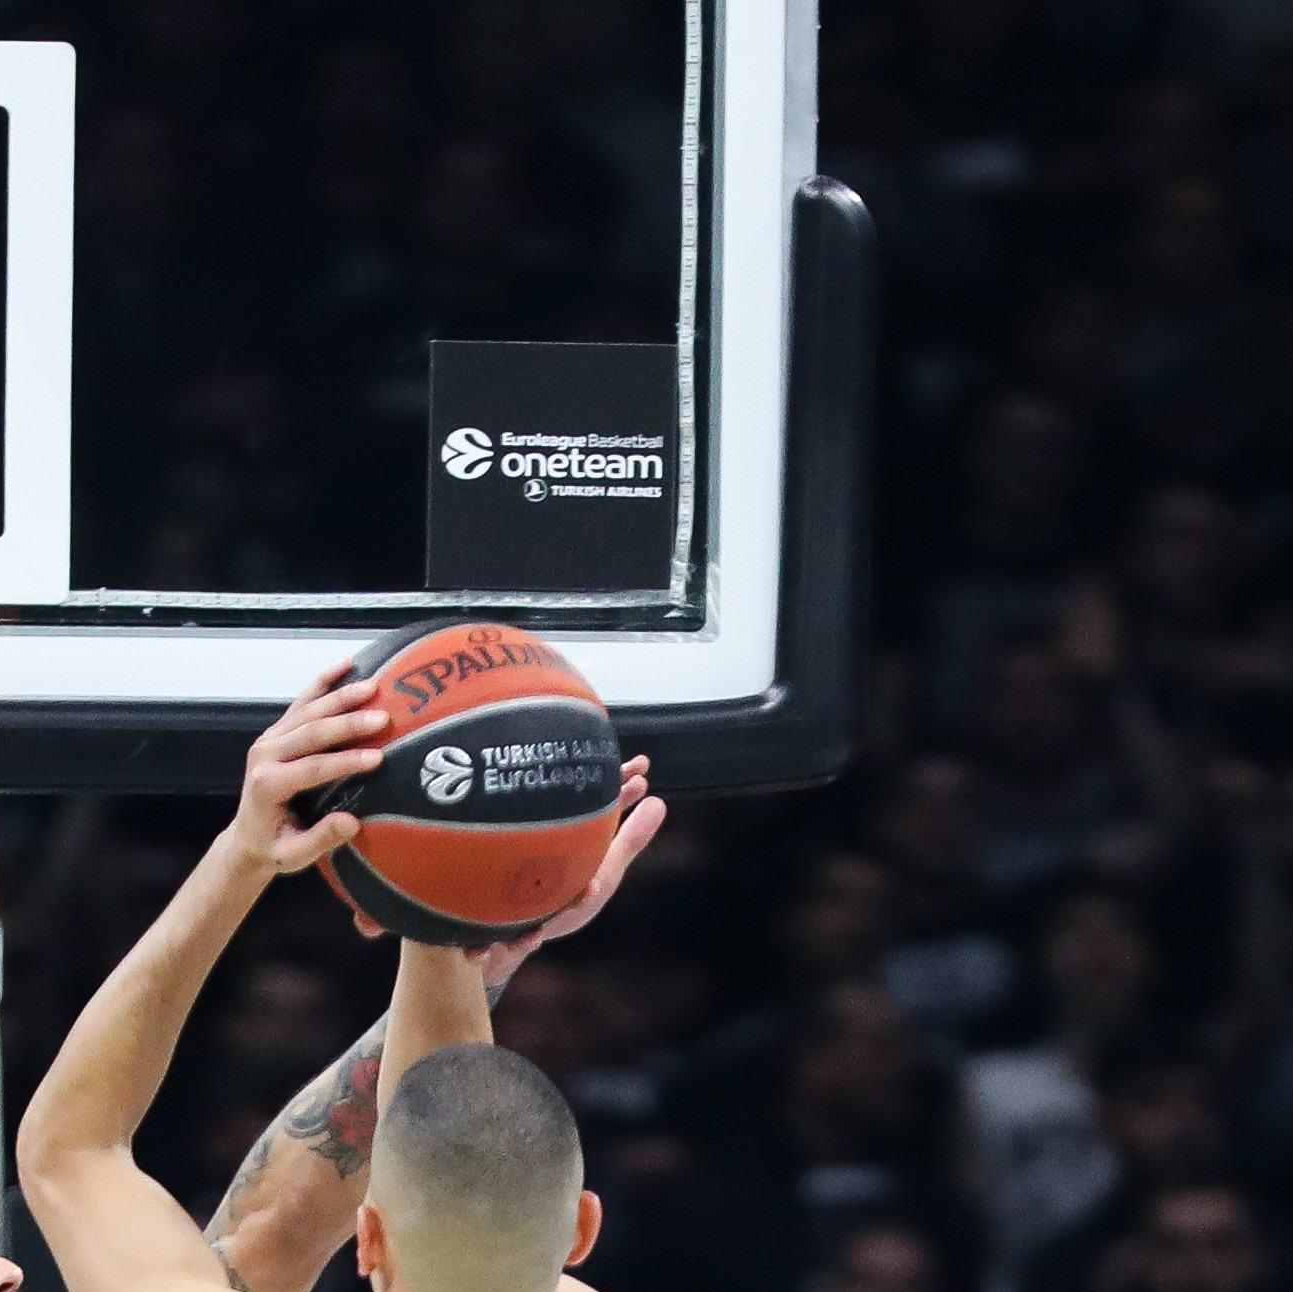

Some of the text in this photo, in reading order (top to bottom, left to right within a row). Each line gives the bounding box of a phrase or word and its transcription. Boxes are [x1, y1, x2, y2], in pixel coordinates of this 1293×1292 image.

[587, 433, 665, 449] Basketball
[500, 448, 664, 479] oneteam
[550, 484, 663, 498] TURKISH AIRLINES
